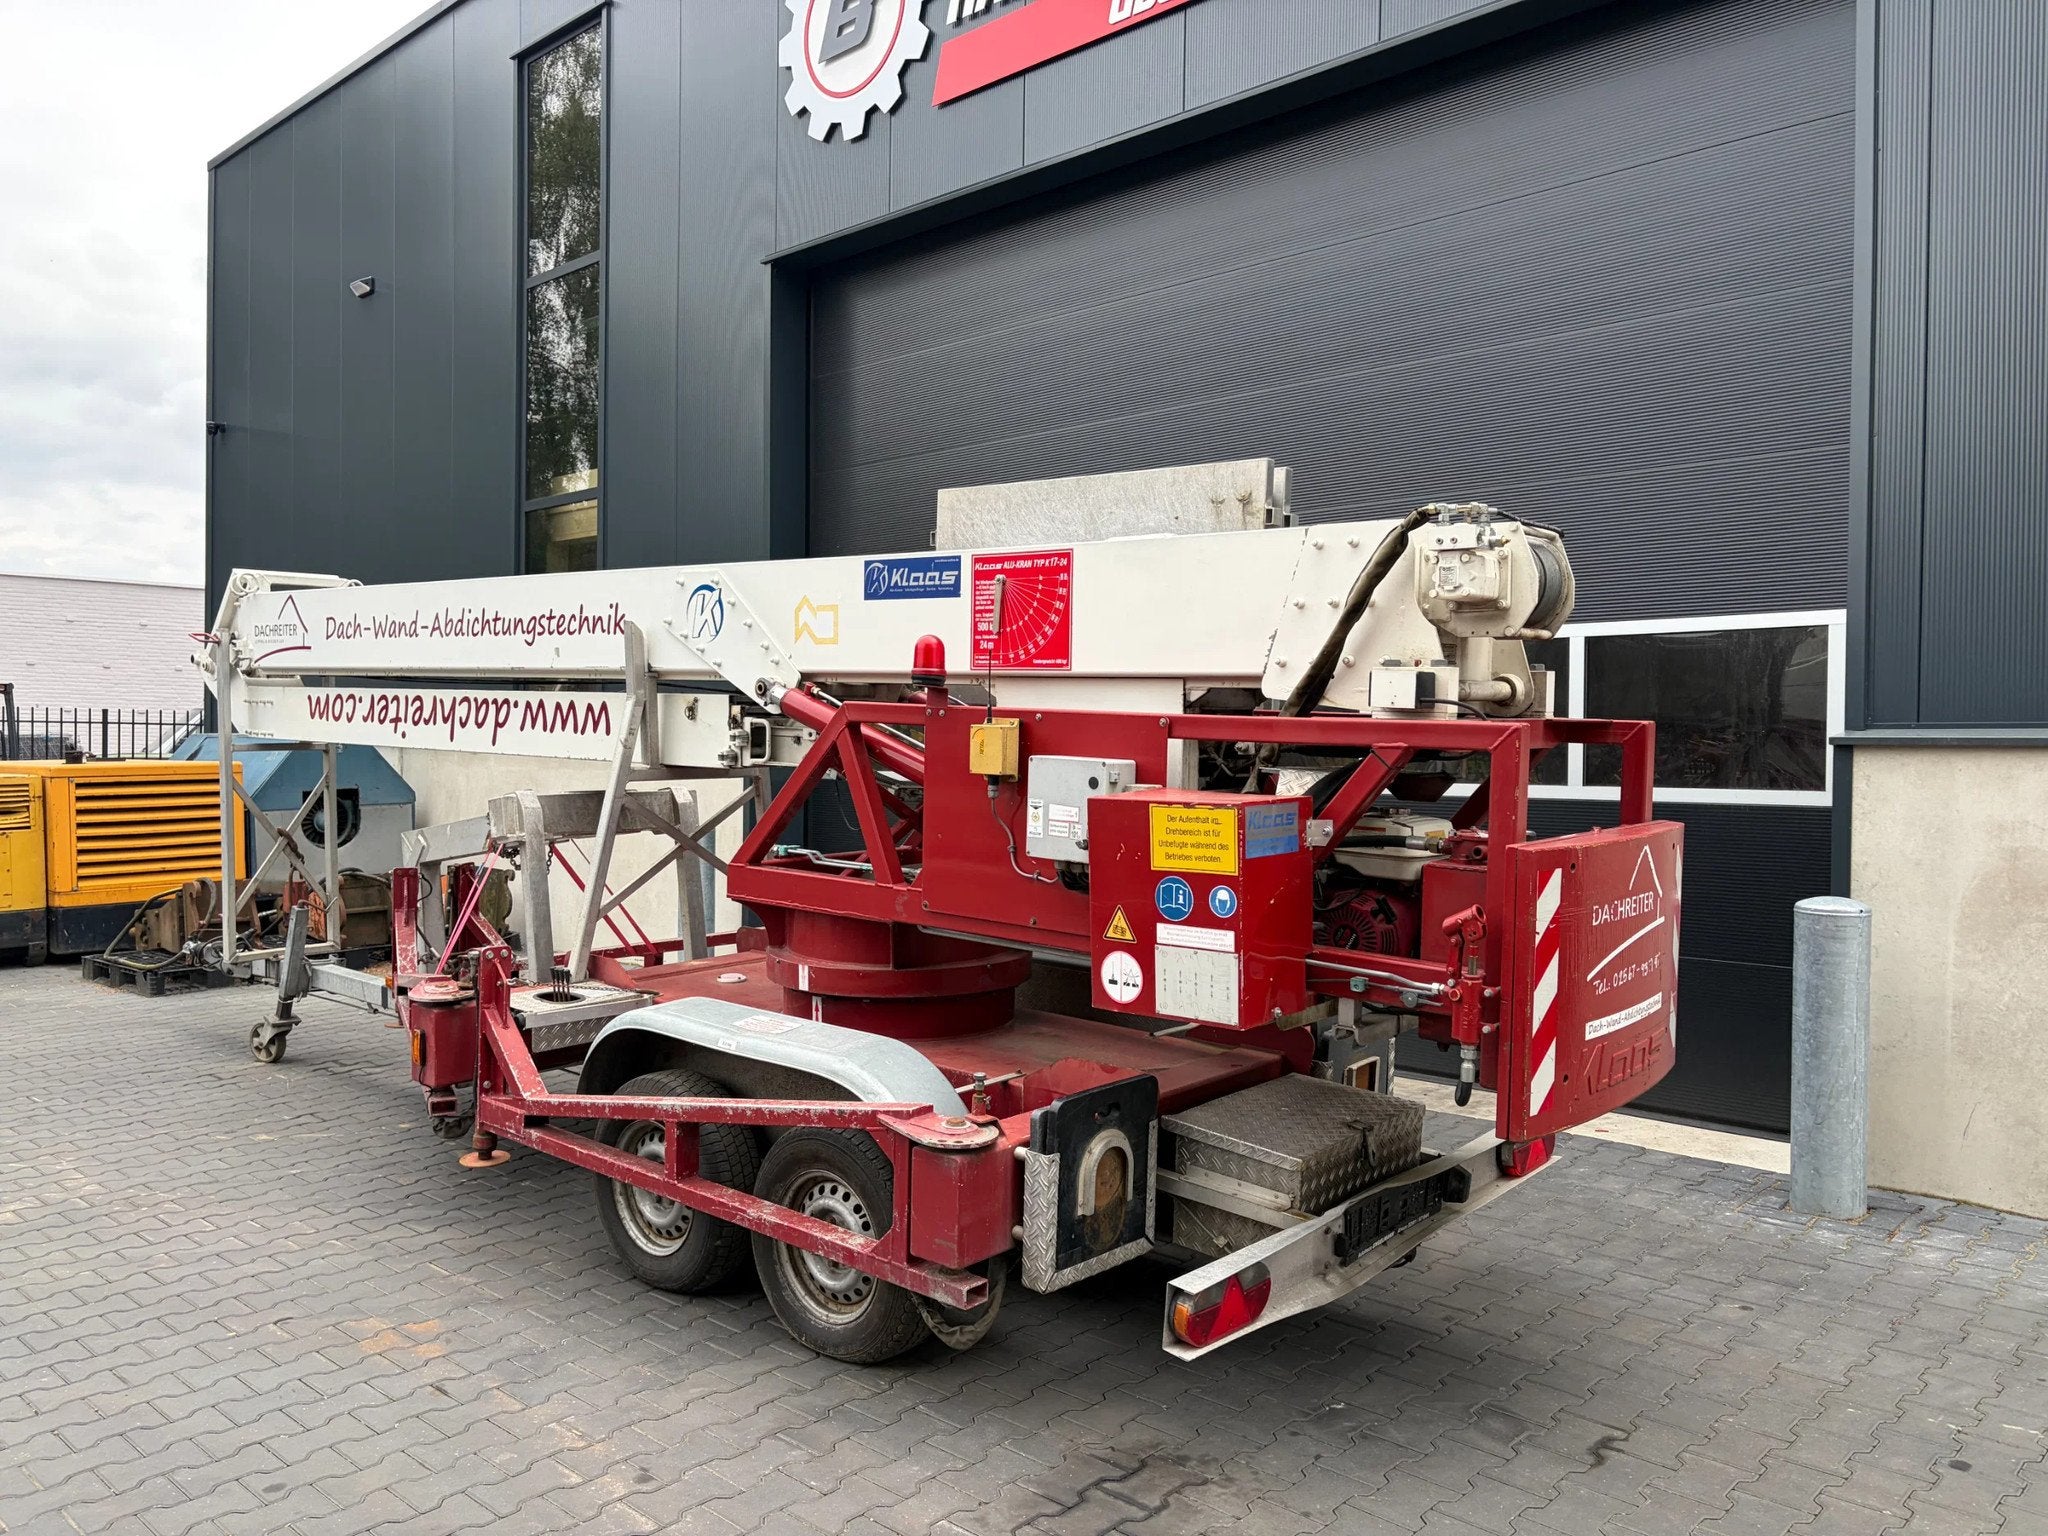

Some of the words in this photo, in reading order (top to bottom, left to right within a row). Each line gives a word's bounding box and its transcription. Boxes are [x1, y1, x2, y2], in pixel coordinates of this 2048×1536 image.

[1003, 559, 1032, 569] ALU-KRAN
[1033, 558, 1044, 568] TYP
[890, 567, 959, 586] Klaas
[325, 602, 625, 646] Dach-Wand-Abdichtungstechnik
[254, 624, 298, 637] DACHREITER
[307, 692, 611, 746] www.dachreiter.com
[1167, 814, 1177, 822] Der
[1179, 815, 1209, 824] Aufenthalt
[1165, 827, 1201, 836] Drehbereich
[1212, 829, 1221, 837] für
[1158, 840, 1188, 849] Unbefugte
[1190, 842, 1216, 850] während
[1164, 852, 1193, 861] Betriebes
[1592, 891, 1654, 926] DACHREITER
